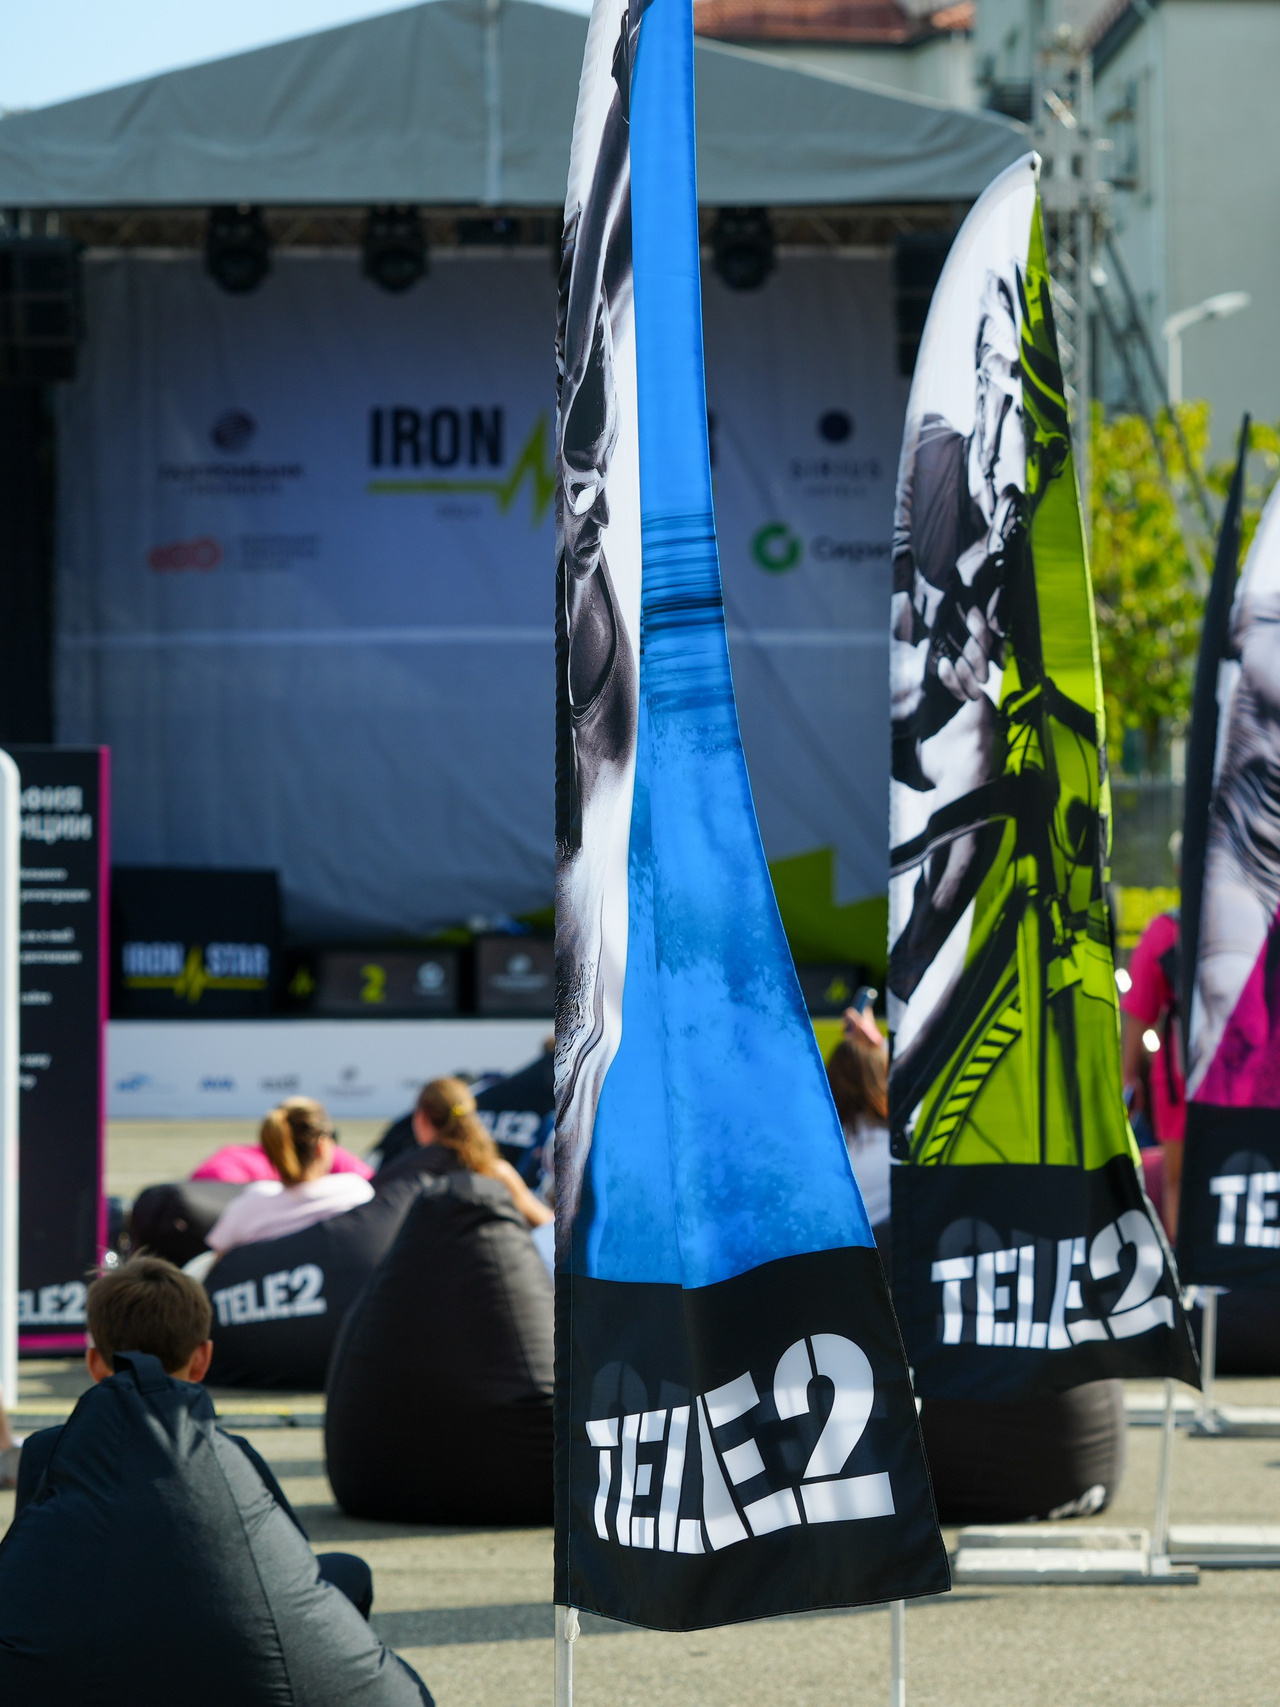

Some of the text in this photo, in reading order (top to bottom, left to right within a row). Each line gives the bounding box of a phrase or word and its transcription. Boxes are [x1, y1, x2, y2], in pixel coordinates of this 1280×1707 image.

[370, 406, 504, 469] IRON
[20, 785, 83, 812] ФИЯ
[122, 942, 184, 976] IRON
[205, 943, 270, 978] STAR
[359, 964, 386, 1002] 2
[478, 1110, 541, 1147] LE2
[212, 1263, 327, 1327] TELE2
[931, 1209, 1175, 1350] TELE2
[19, 1281, 87, 1324] ELE2
[585, 1333, 896, 1555] TELE2
